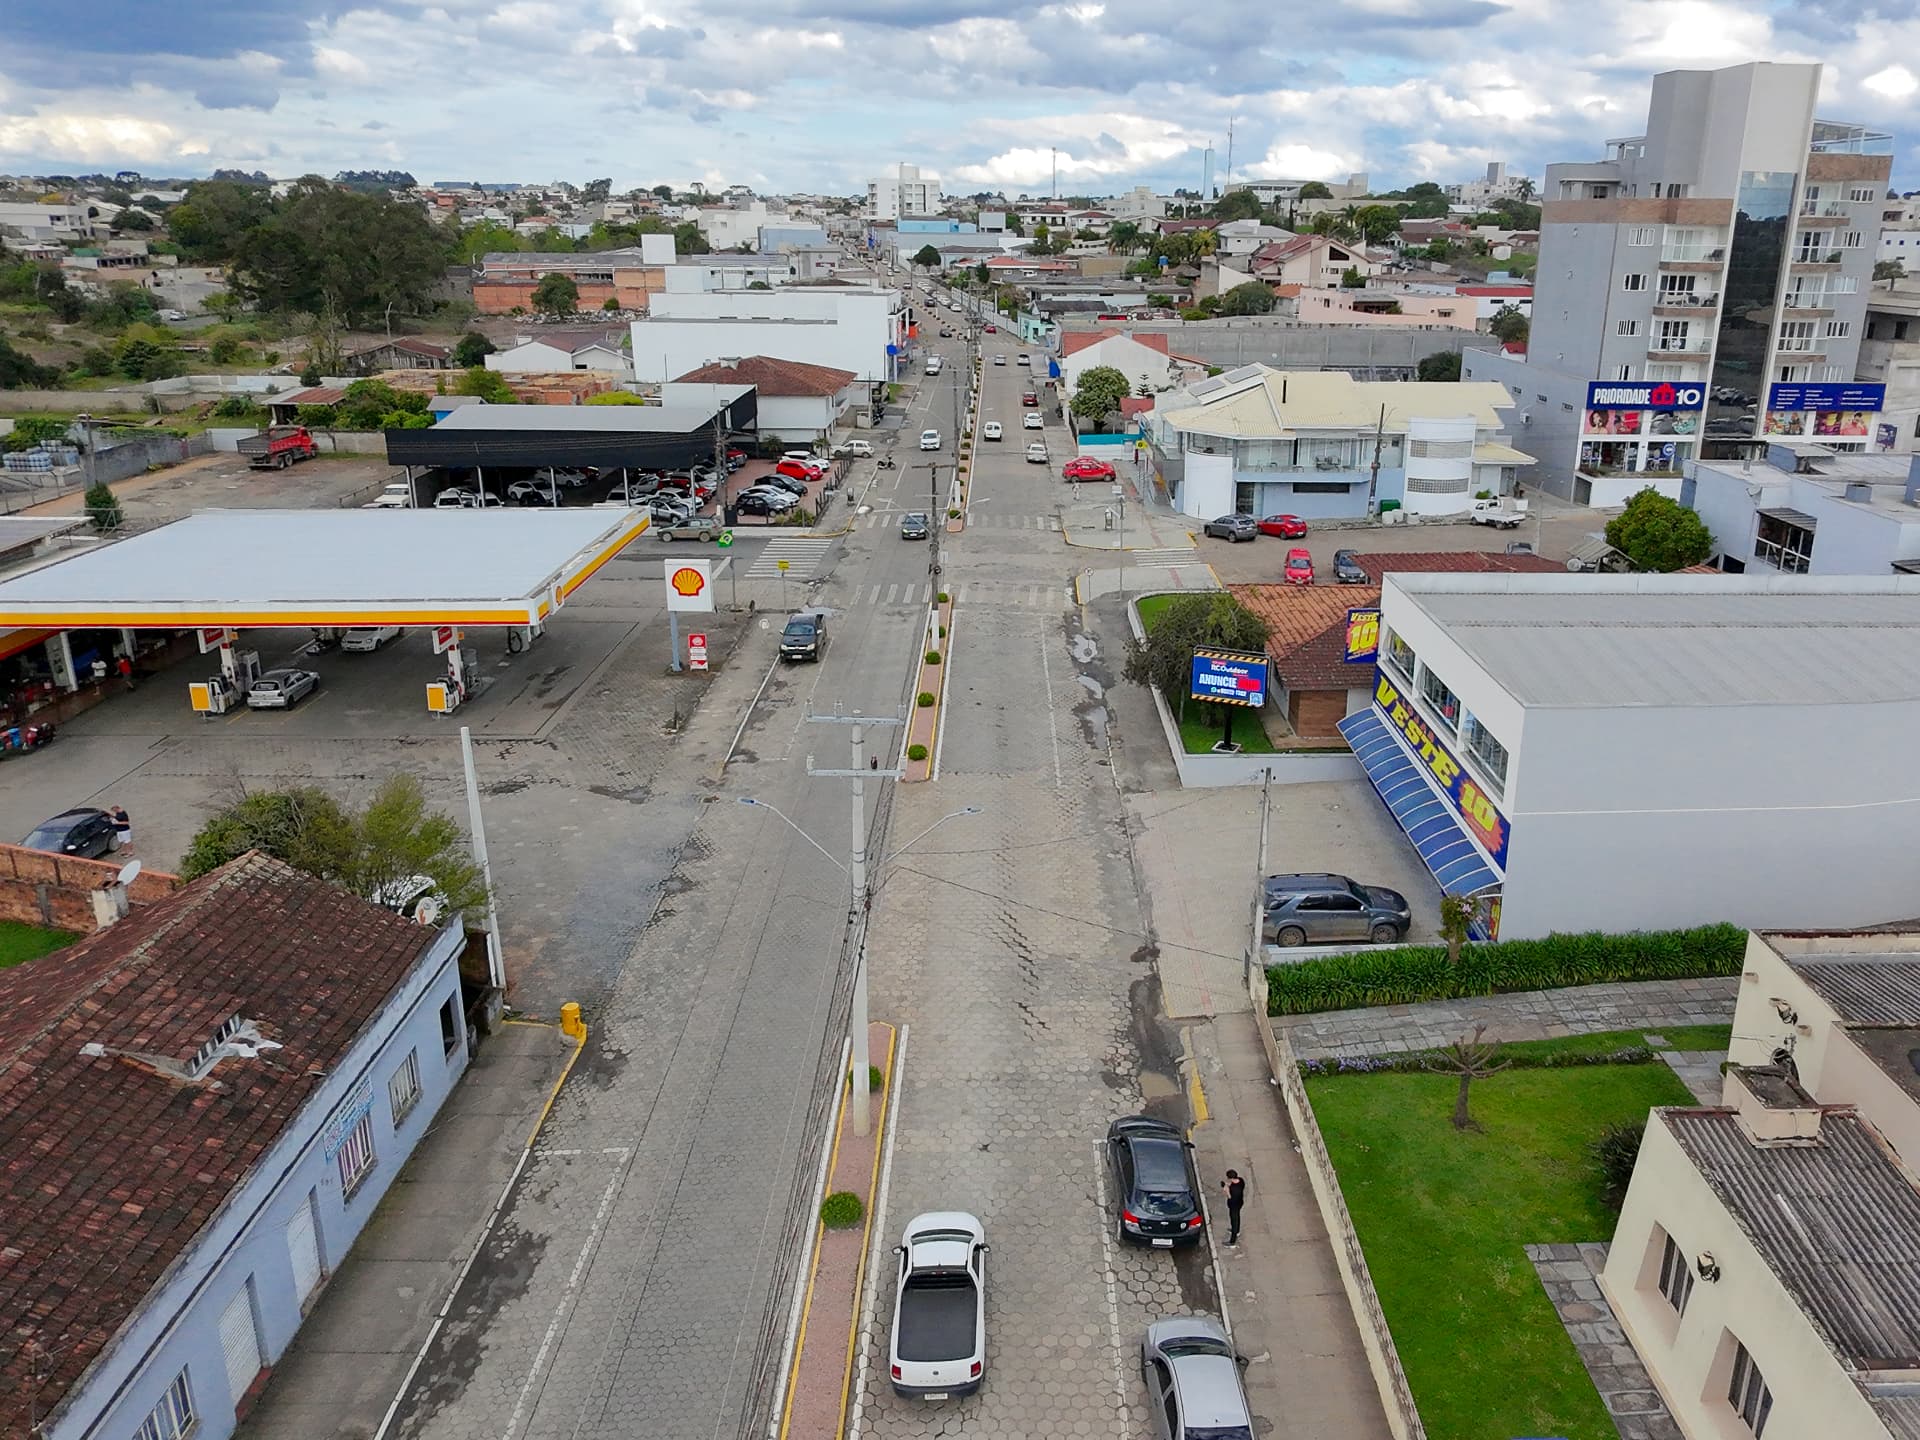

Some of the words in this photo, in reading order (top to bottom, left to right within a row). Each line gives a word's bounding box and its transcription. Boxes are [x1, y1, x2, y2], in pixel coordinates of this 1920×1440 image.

[1593, 388, 1651, 404] PRIORIDADE
[1676, 389, 1700, 405] 10
[1350, 612, 1379, 622] VESTE
[1348, 621, 1378, 653] 10
[1199, 673, 1237, 688] ANUNCIE
[1376, 676, 1460, 786] VESTE
[1460, 783, 1497, 831] 10
